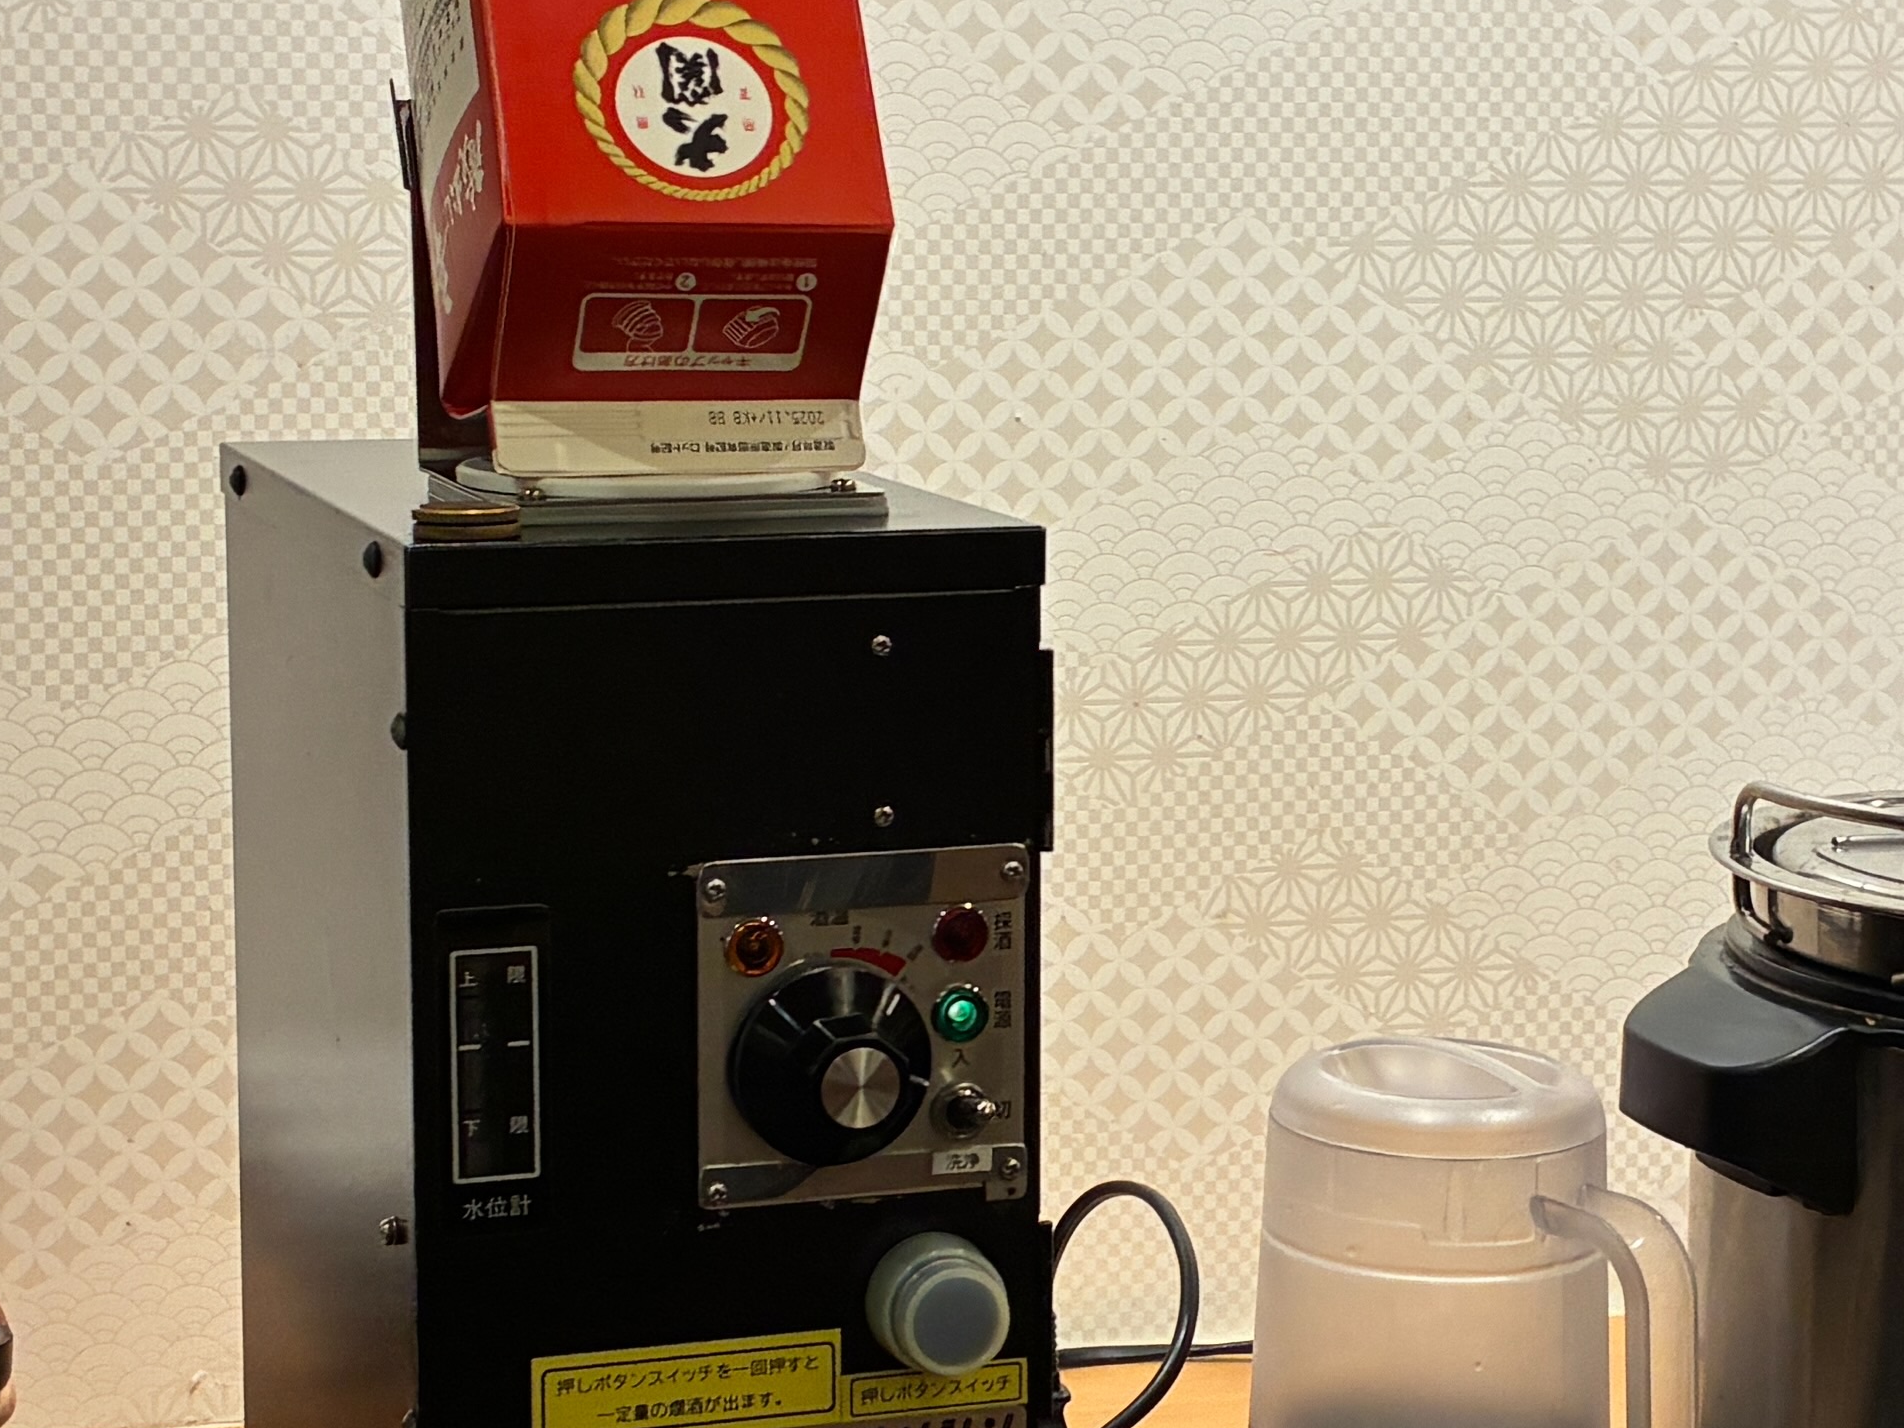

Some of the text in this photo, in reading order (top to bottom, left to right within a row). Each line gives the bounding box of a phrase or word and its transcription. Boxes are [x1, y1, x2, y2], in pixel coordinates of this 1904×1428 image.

[656, 42, 729, 173] 大関
[950, 1048, 971, 1068] 入
[462, 1194, 532, 1221] 水位計
[860, 1374, 1012, 1406] 押しボタンスイッチ
